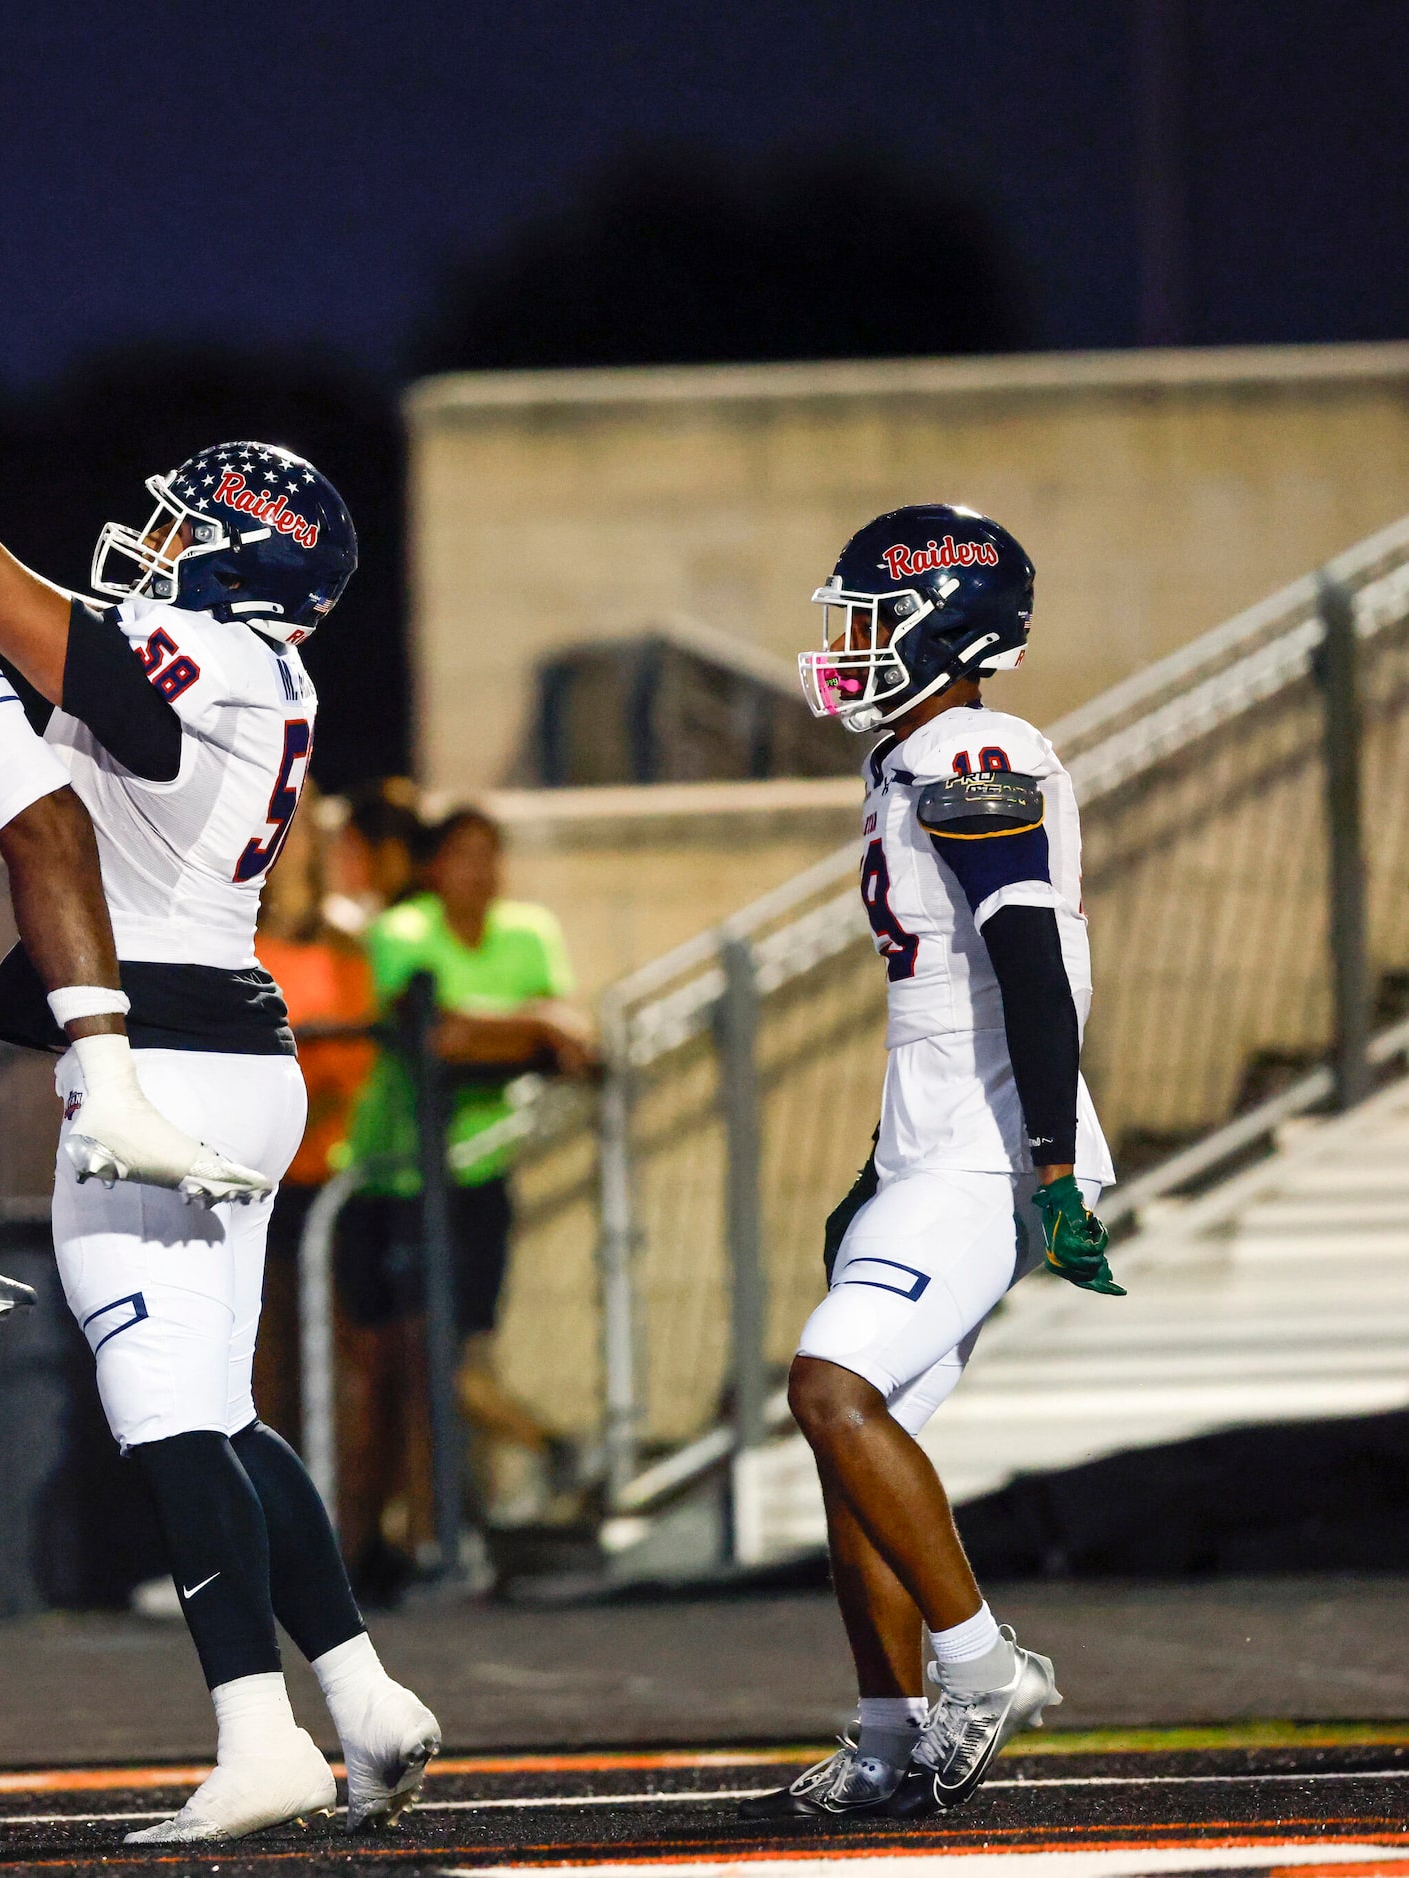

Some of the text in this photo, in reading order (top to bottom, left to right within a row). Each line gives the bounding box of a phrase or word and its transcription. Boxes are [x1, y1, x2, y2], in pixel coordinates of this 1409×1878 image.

[213, 471, 319, 549] Raiders
[883, 534, 999, 580] Raiders
[133, 626, 201, 703] 58
[232, 717, 315, 882] 5
